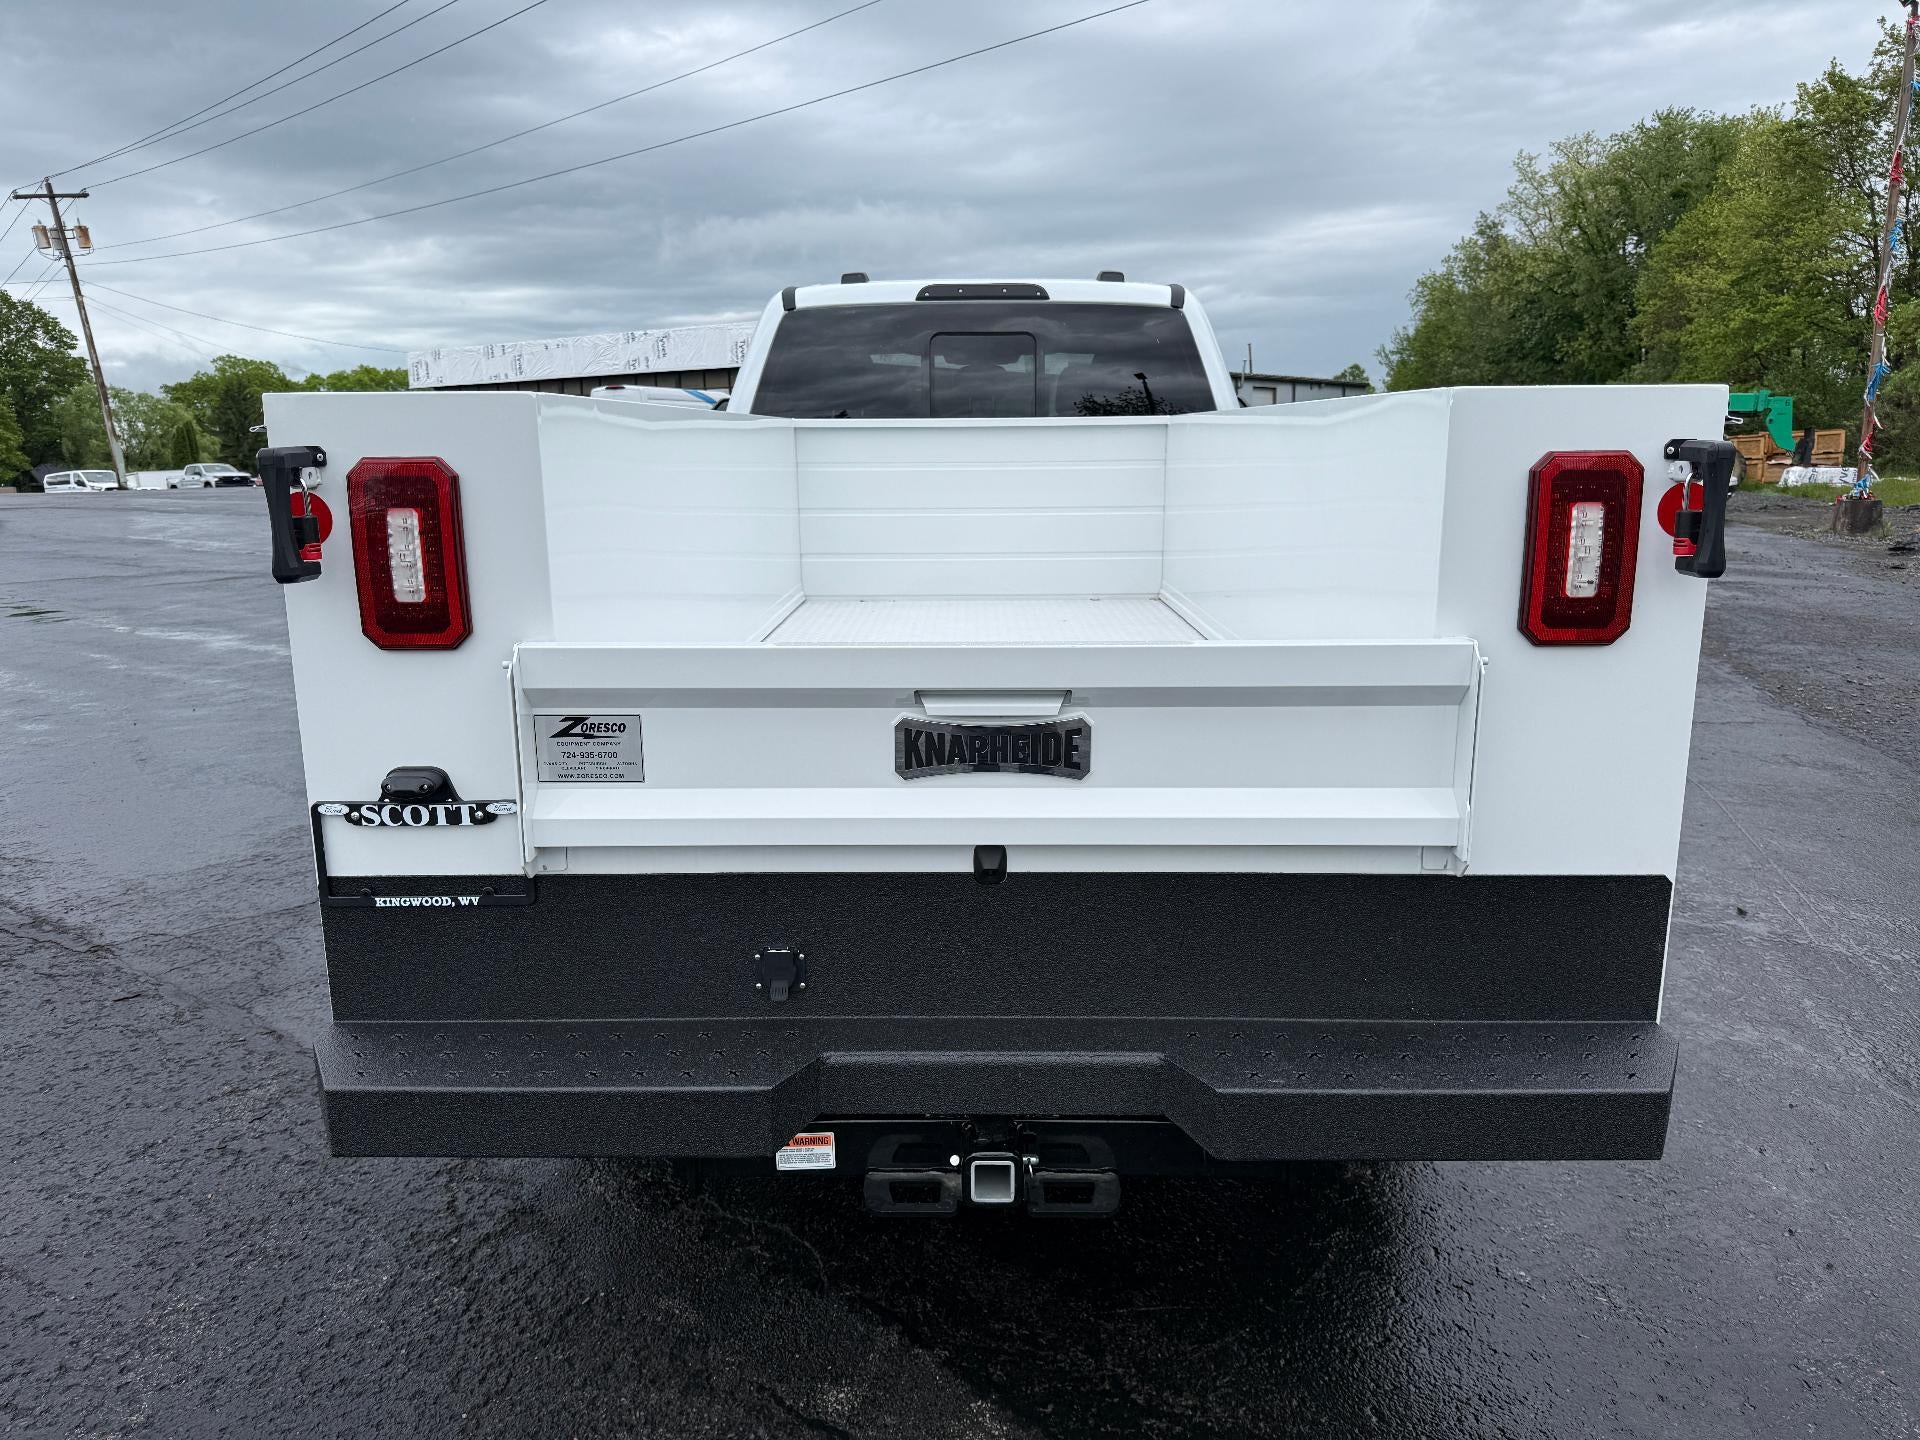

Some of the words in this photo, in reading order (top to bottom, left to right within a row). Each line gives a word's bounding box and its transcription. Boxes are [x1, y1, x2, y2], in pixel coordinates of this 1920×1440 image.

[549, 717, 626, 739] ZORESCO
[561, 751, 618, 759] 724-935-6700
[904, 727, 1083, 770] KNAPHEIDE
[360, 804, 477, 827] SCOTT
[375, 897, 455, 908] KINGWOOD,
[458, 897, 480, 906] WV
[792, 1136, 829, 1146] WARNING
